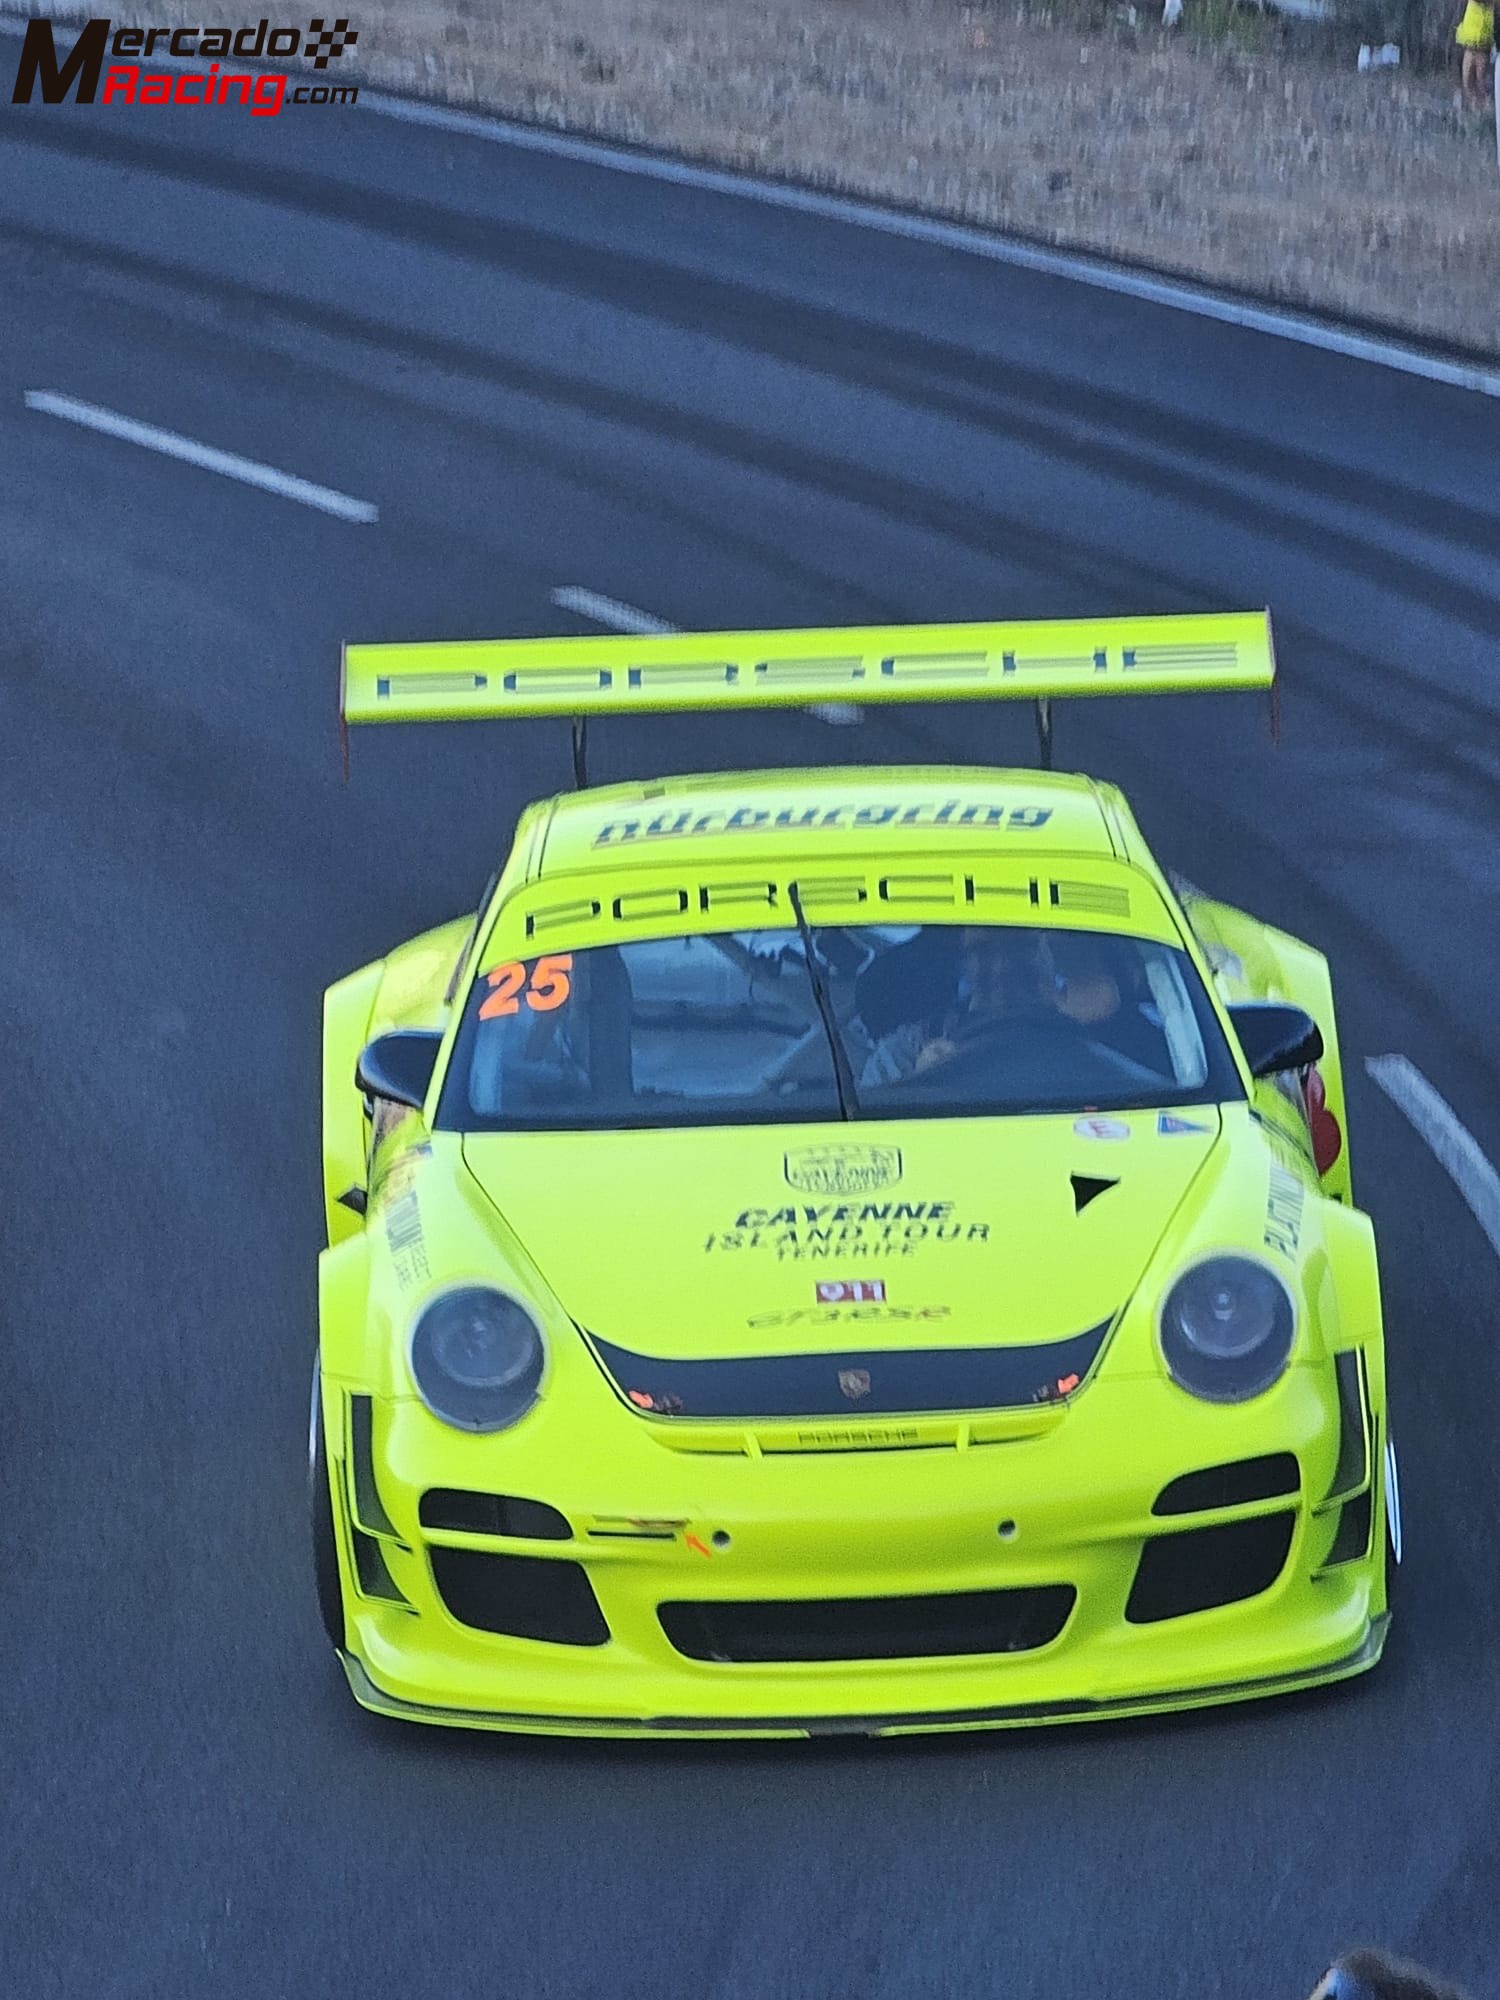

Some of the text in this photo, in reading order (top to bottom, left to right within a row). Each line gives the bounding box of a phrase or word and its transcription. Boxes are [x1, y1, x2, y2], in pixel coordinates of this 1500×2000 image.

[376, 641, 1238, 699] PORSCHE
[525, 873, 1130, 939] PORSCHE
[477, 953, 574, 1020] 25
[735, 1200, 955, 1229] CAYENNE
[704, 1222, 991, 1253] ISLAND TOUR
[777, 1241, 917, 1262] TENERIFE
